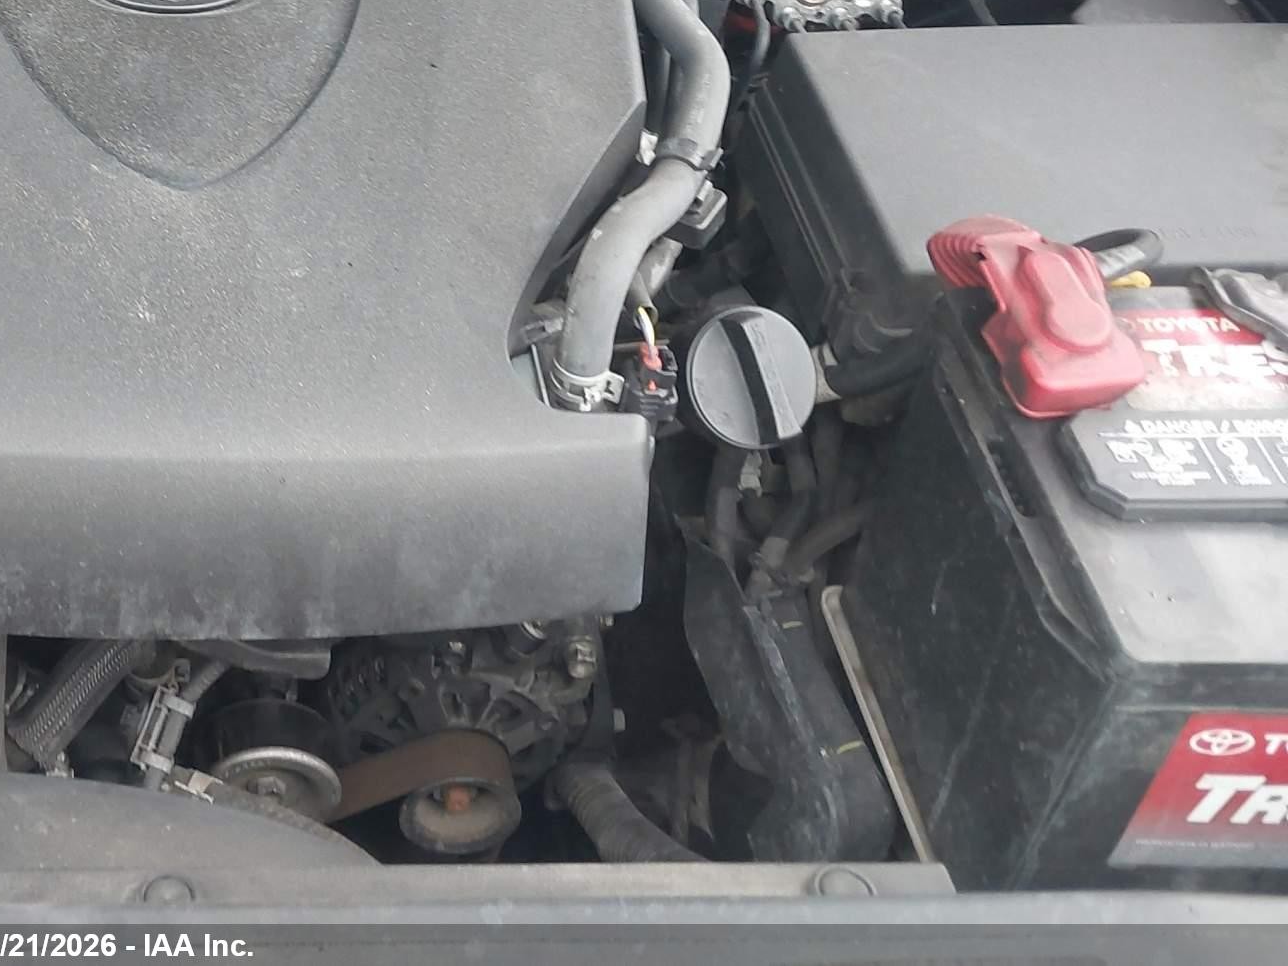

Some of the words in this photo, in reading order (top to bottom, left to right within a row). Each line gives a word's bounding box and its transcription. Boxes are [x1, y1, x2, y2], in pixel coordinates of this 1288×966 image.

[1136, 316, 1240, 332] TOYOTA
[1264, 733, 1288, 755] T
[1185, 774, 1288, 824] TR
